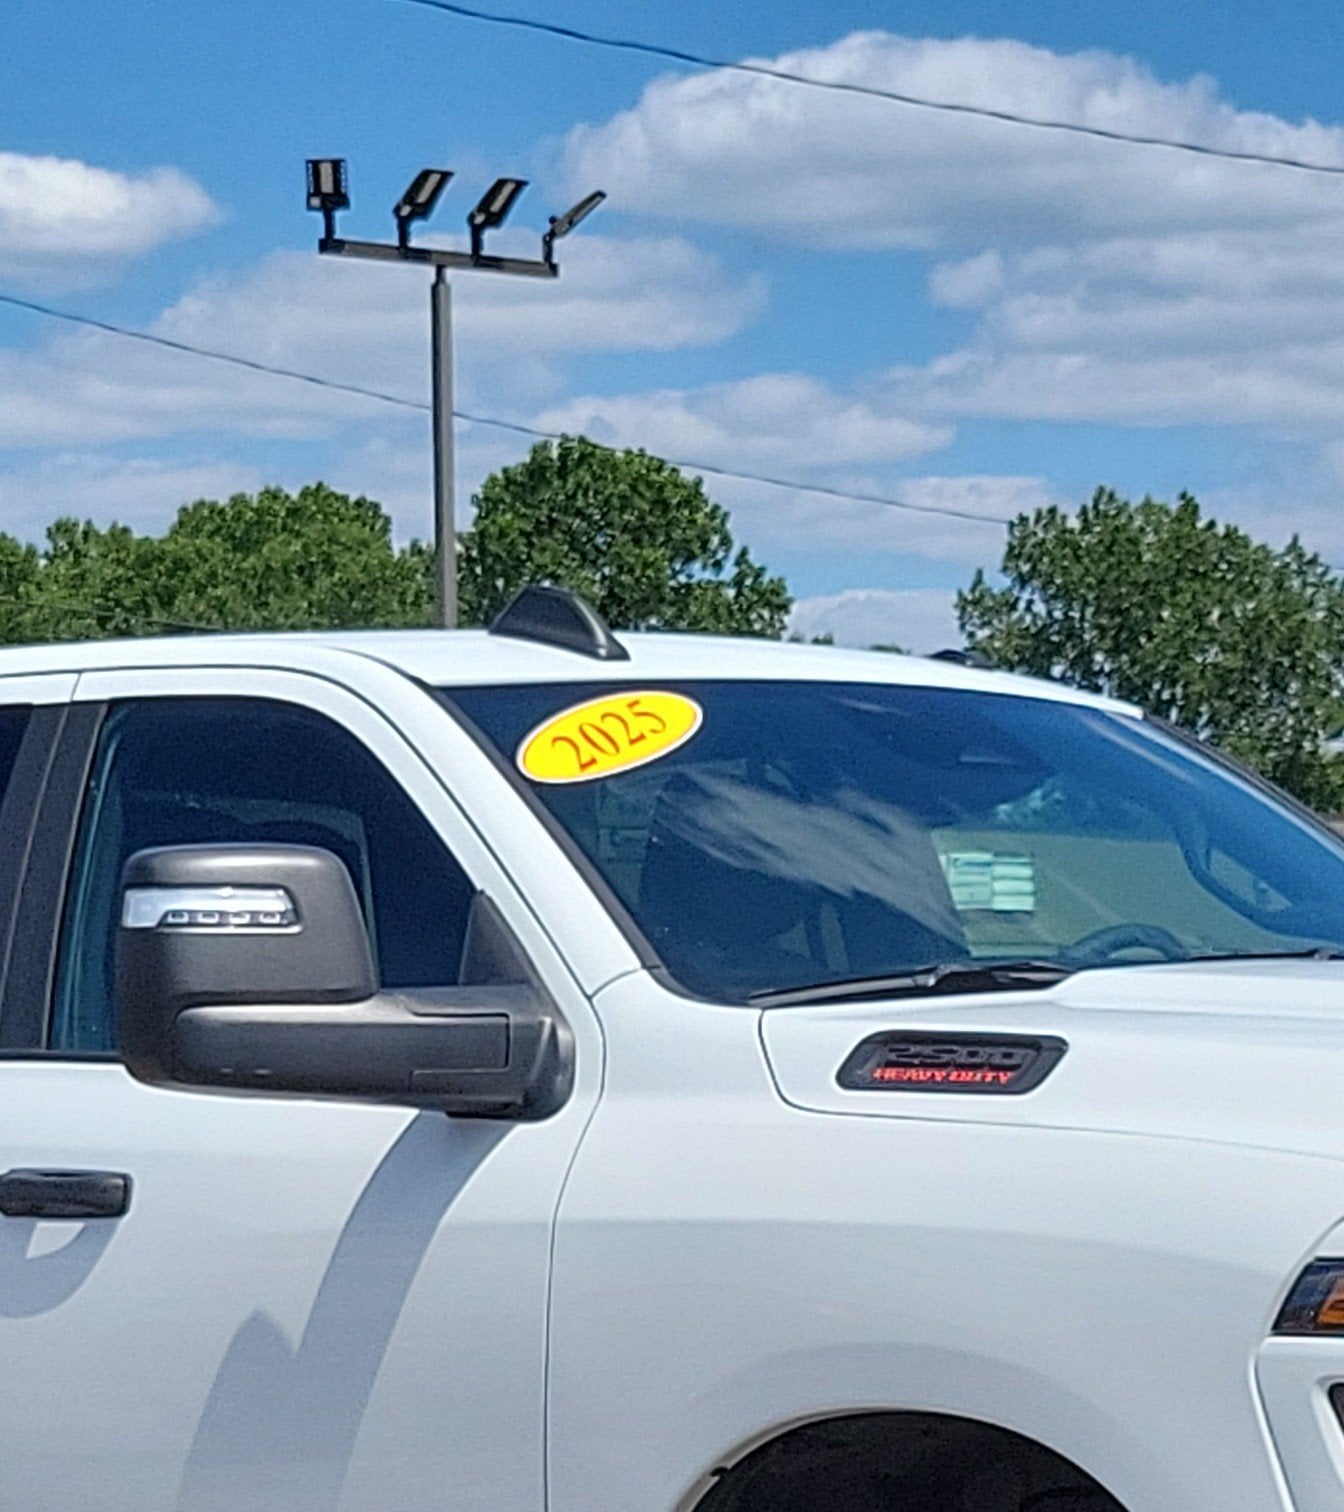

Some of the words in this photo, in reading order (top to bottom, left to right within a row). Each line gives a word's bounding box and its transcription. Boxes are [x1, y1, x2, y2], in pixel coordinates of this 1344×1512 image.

[551, 700, 666, 771] 2025
[872, 1067, 947, 1083] HEAVY
[948, 1068, 1014, 1084] DUTY
